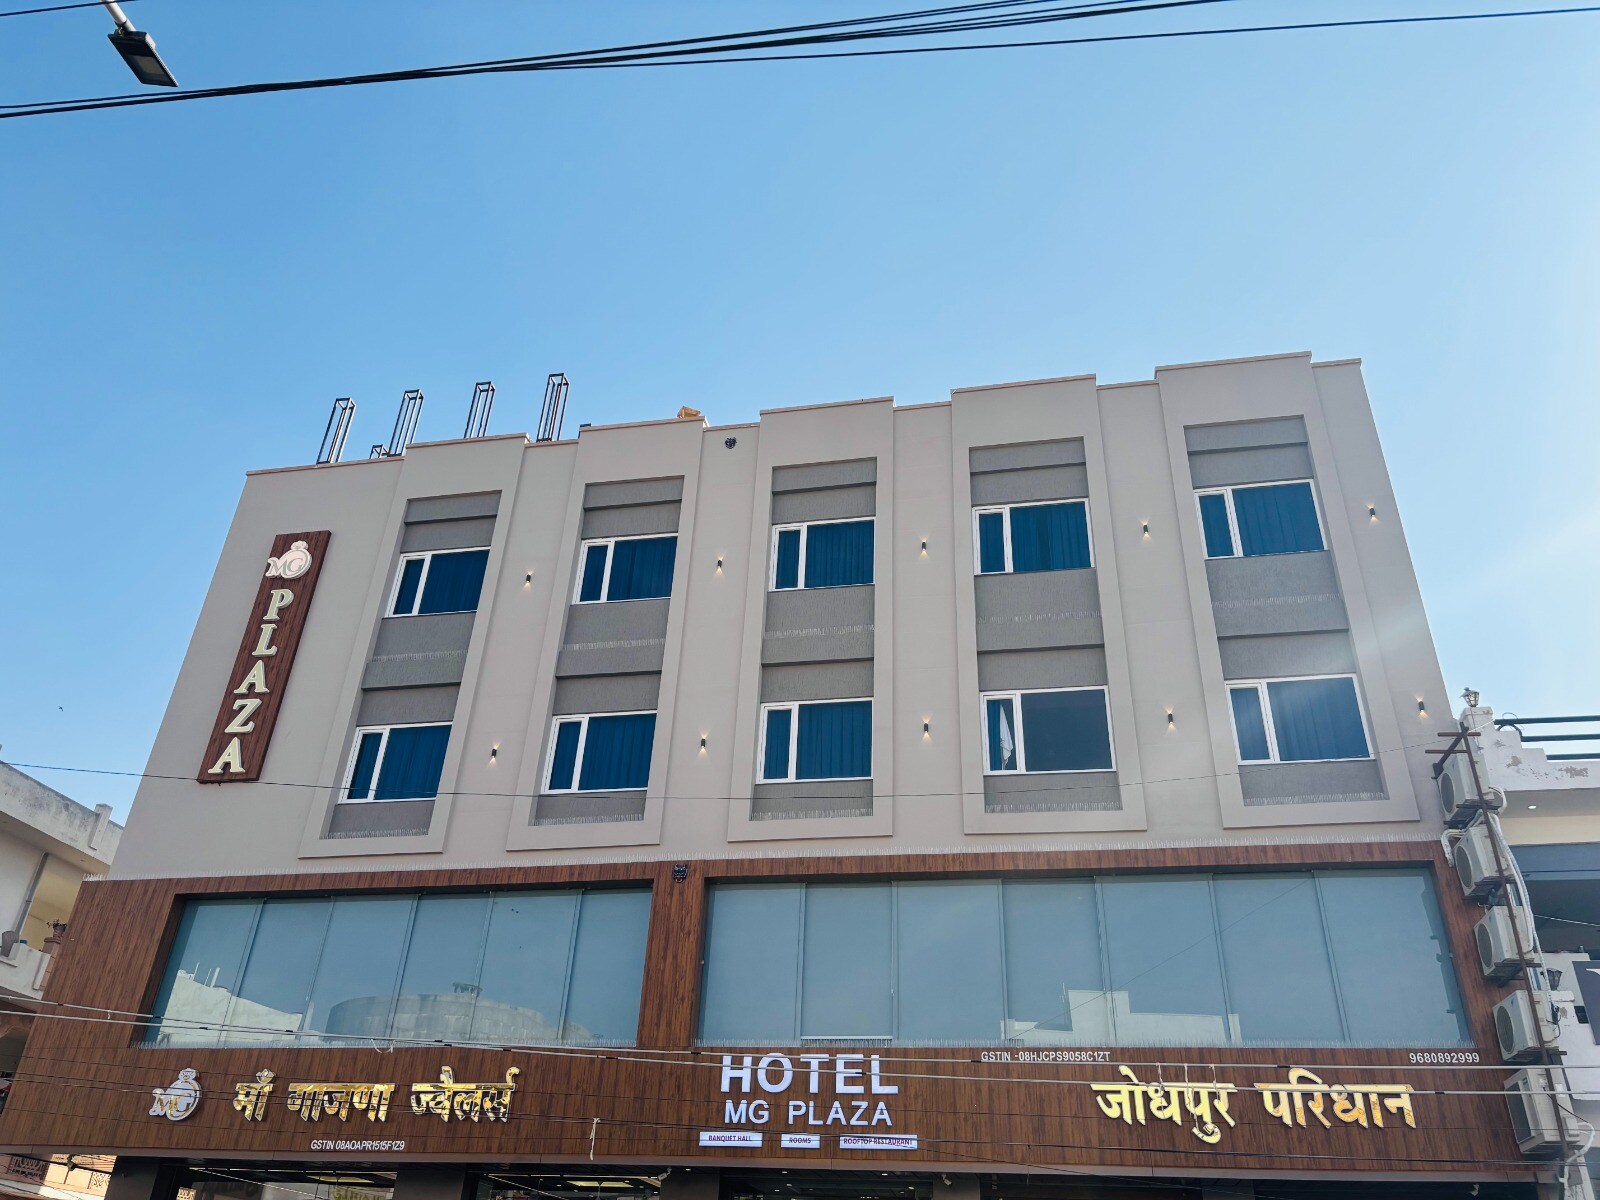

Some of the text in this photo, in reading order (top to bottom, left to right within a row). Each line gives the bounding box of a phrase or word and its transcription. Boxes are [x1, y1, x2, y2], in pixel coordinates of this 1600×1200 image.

[265, 547, 312, 579] MG
[208, 588, 294, 775] PLAZA
[980, 1051, 1011, 1062] GSTIN
[1409, 1052, 1480, 1063] 9680892999
[720, 1053, 899, 1094] HOTEL
[410, 1065, 521, 1122] ज्वेलर्स
[724, 1100, 893, 1126] MG PLAZA
[1090, 1065, 1417, 1144] जोधपुर परिधान
[310, 1140, 335, 1150] GSTIN
[708, 1135, 752, 1143] BANQUET HALL
[789, 1136, 812, 1144] ROOMS
[843, 1137, 914, 1146] ROOFTOP RESTAURANT
